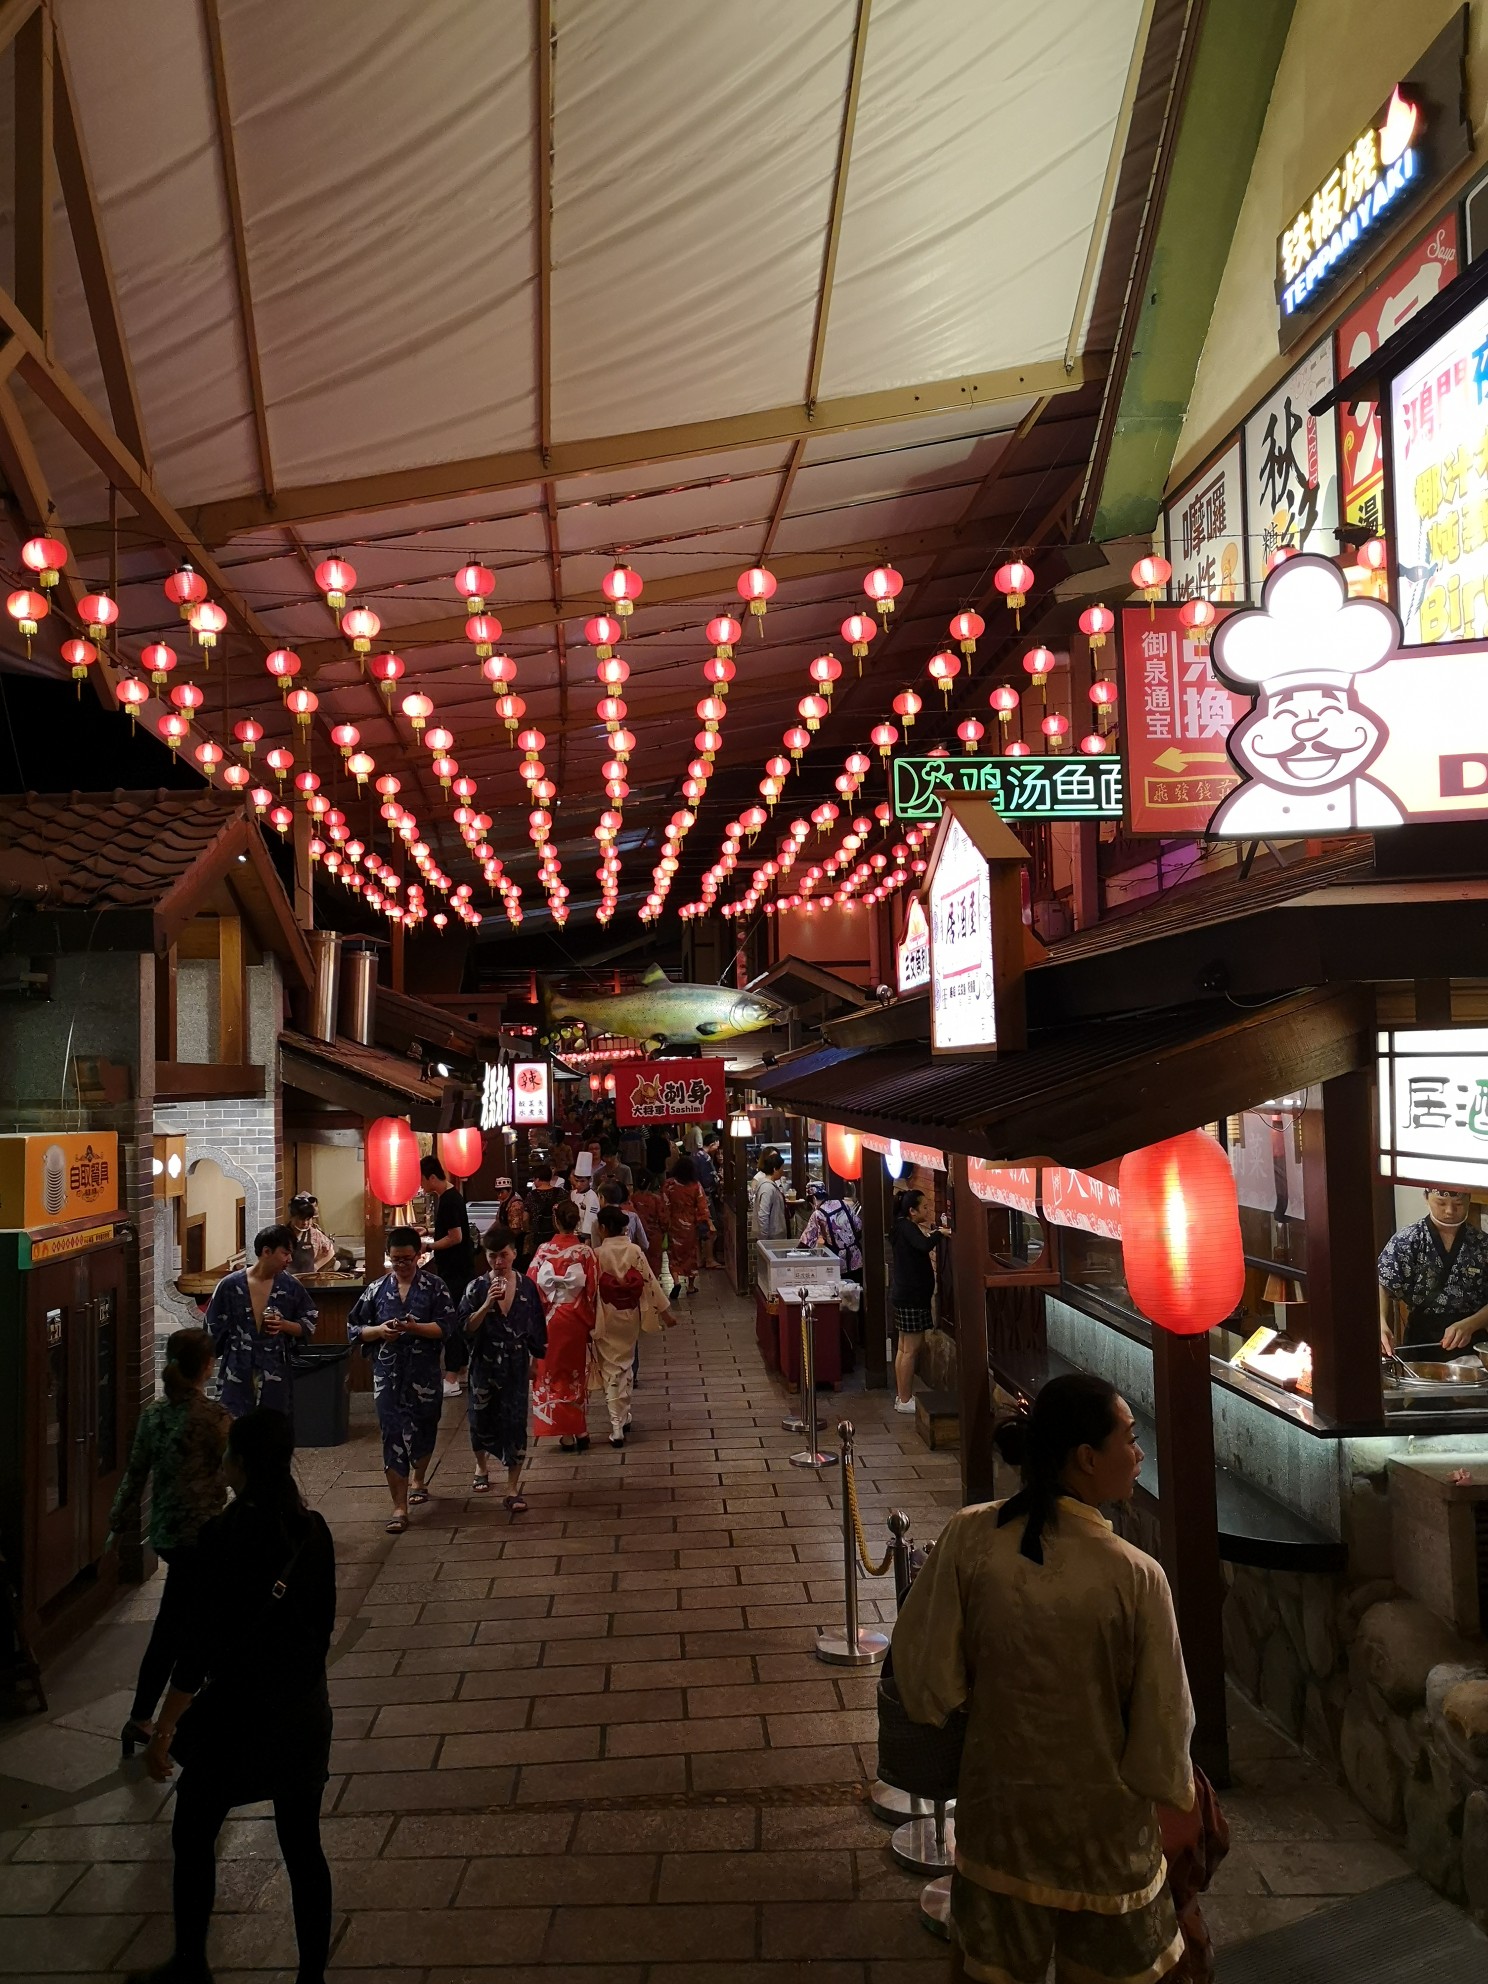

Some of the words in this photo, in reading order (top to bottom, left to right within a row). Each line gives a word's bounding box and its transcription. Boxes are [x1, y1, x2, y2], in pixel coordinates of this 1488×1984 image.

[1281, 127, 1377, 284] 铁板烧
[1282, 148, 1416, 315] TEPPANYAKI
[1427, 229, 1456, 266] Soup
[1307, 416, 1318, 485] SYRUP
[1420, 573, 1488, 643] Bir
[1141, 631, 1171, 739] 御泉通宝
[520, 1070, 541, 1090] 辣
[664, 1079, 711, 1105] 刺身
[670, 1104, 704, 1114] Sashimi
